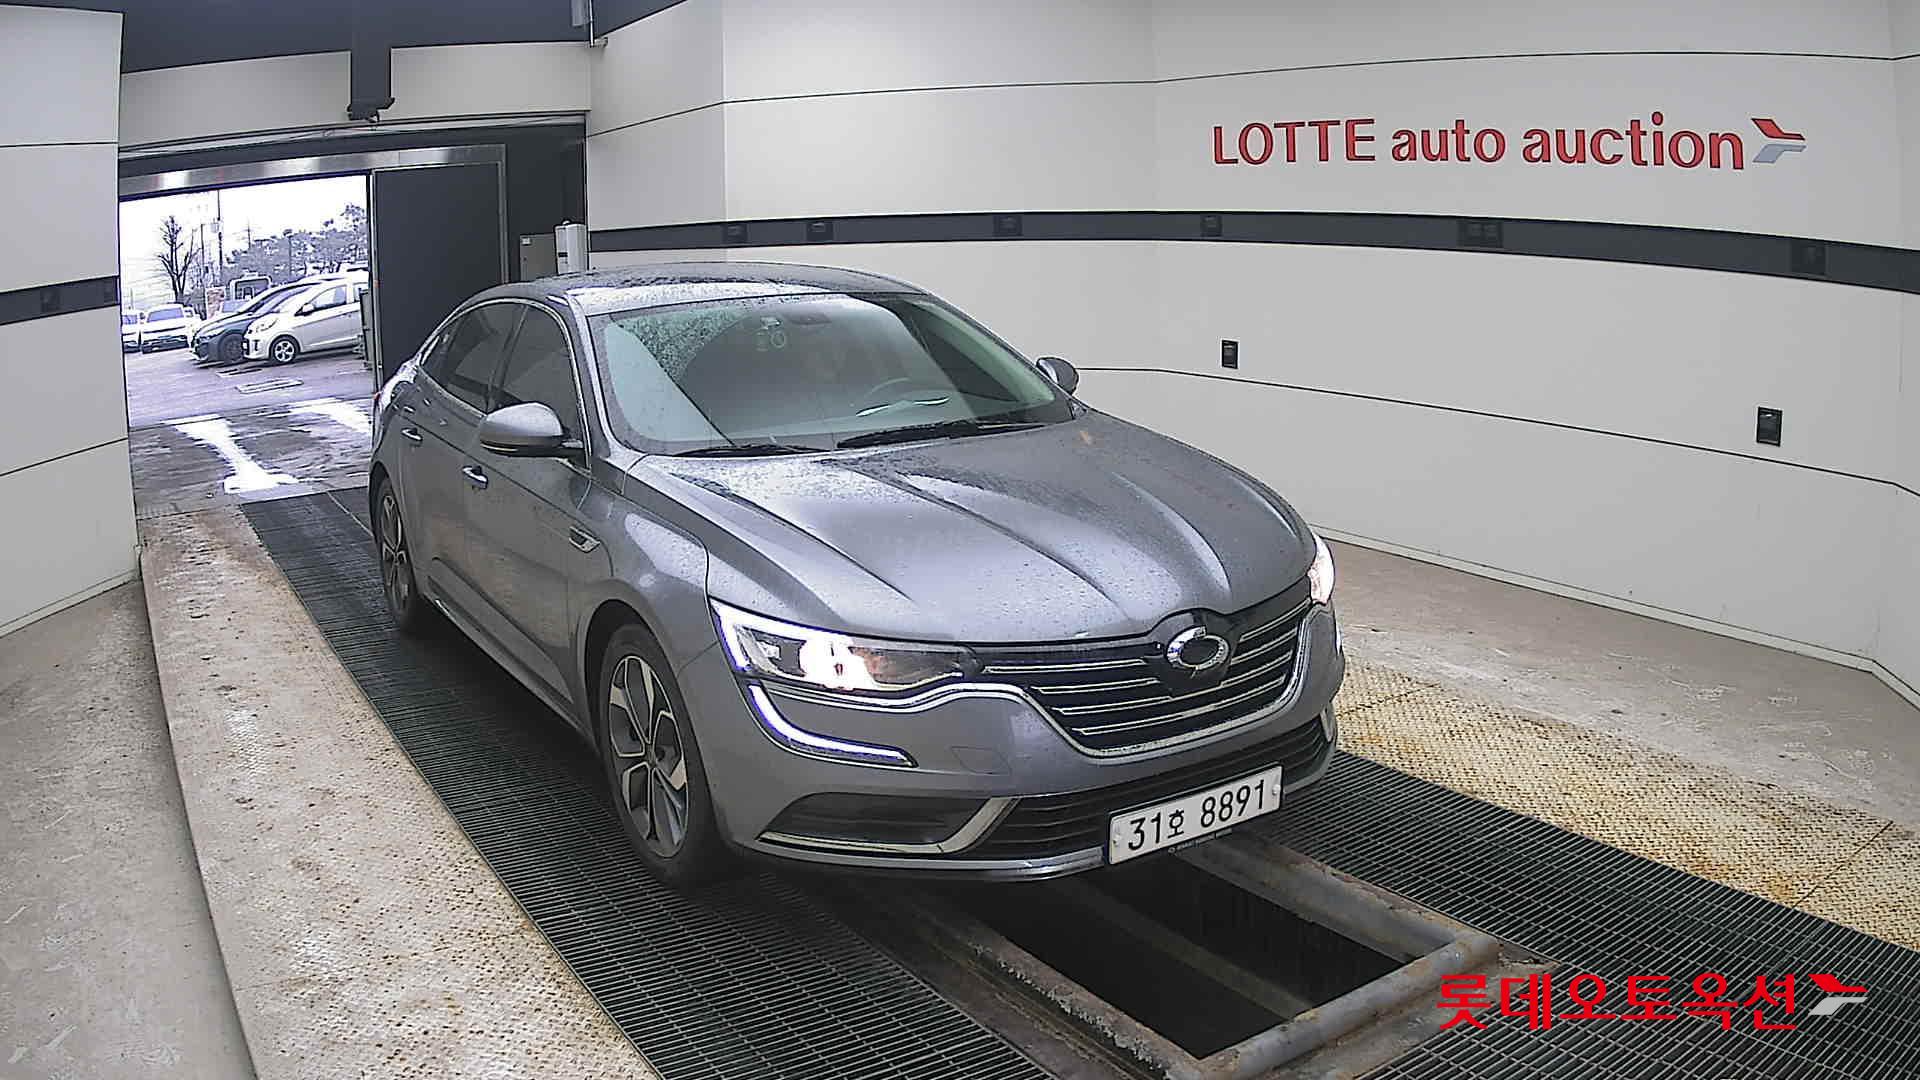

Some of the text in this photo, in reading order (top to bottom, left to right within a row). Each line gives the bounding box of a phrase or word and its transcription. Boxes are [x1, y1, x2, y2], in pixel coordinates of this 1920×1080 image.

[1212, 110, 1744, 171] LOTTE auto auction
[1128, 807, 1186, 851] 31호
[1200, 779, 1265, 828] 8891
